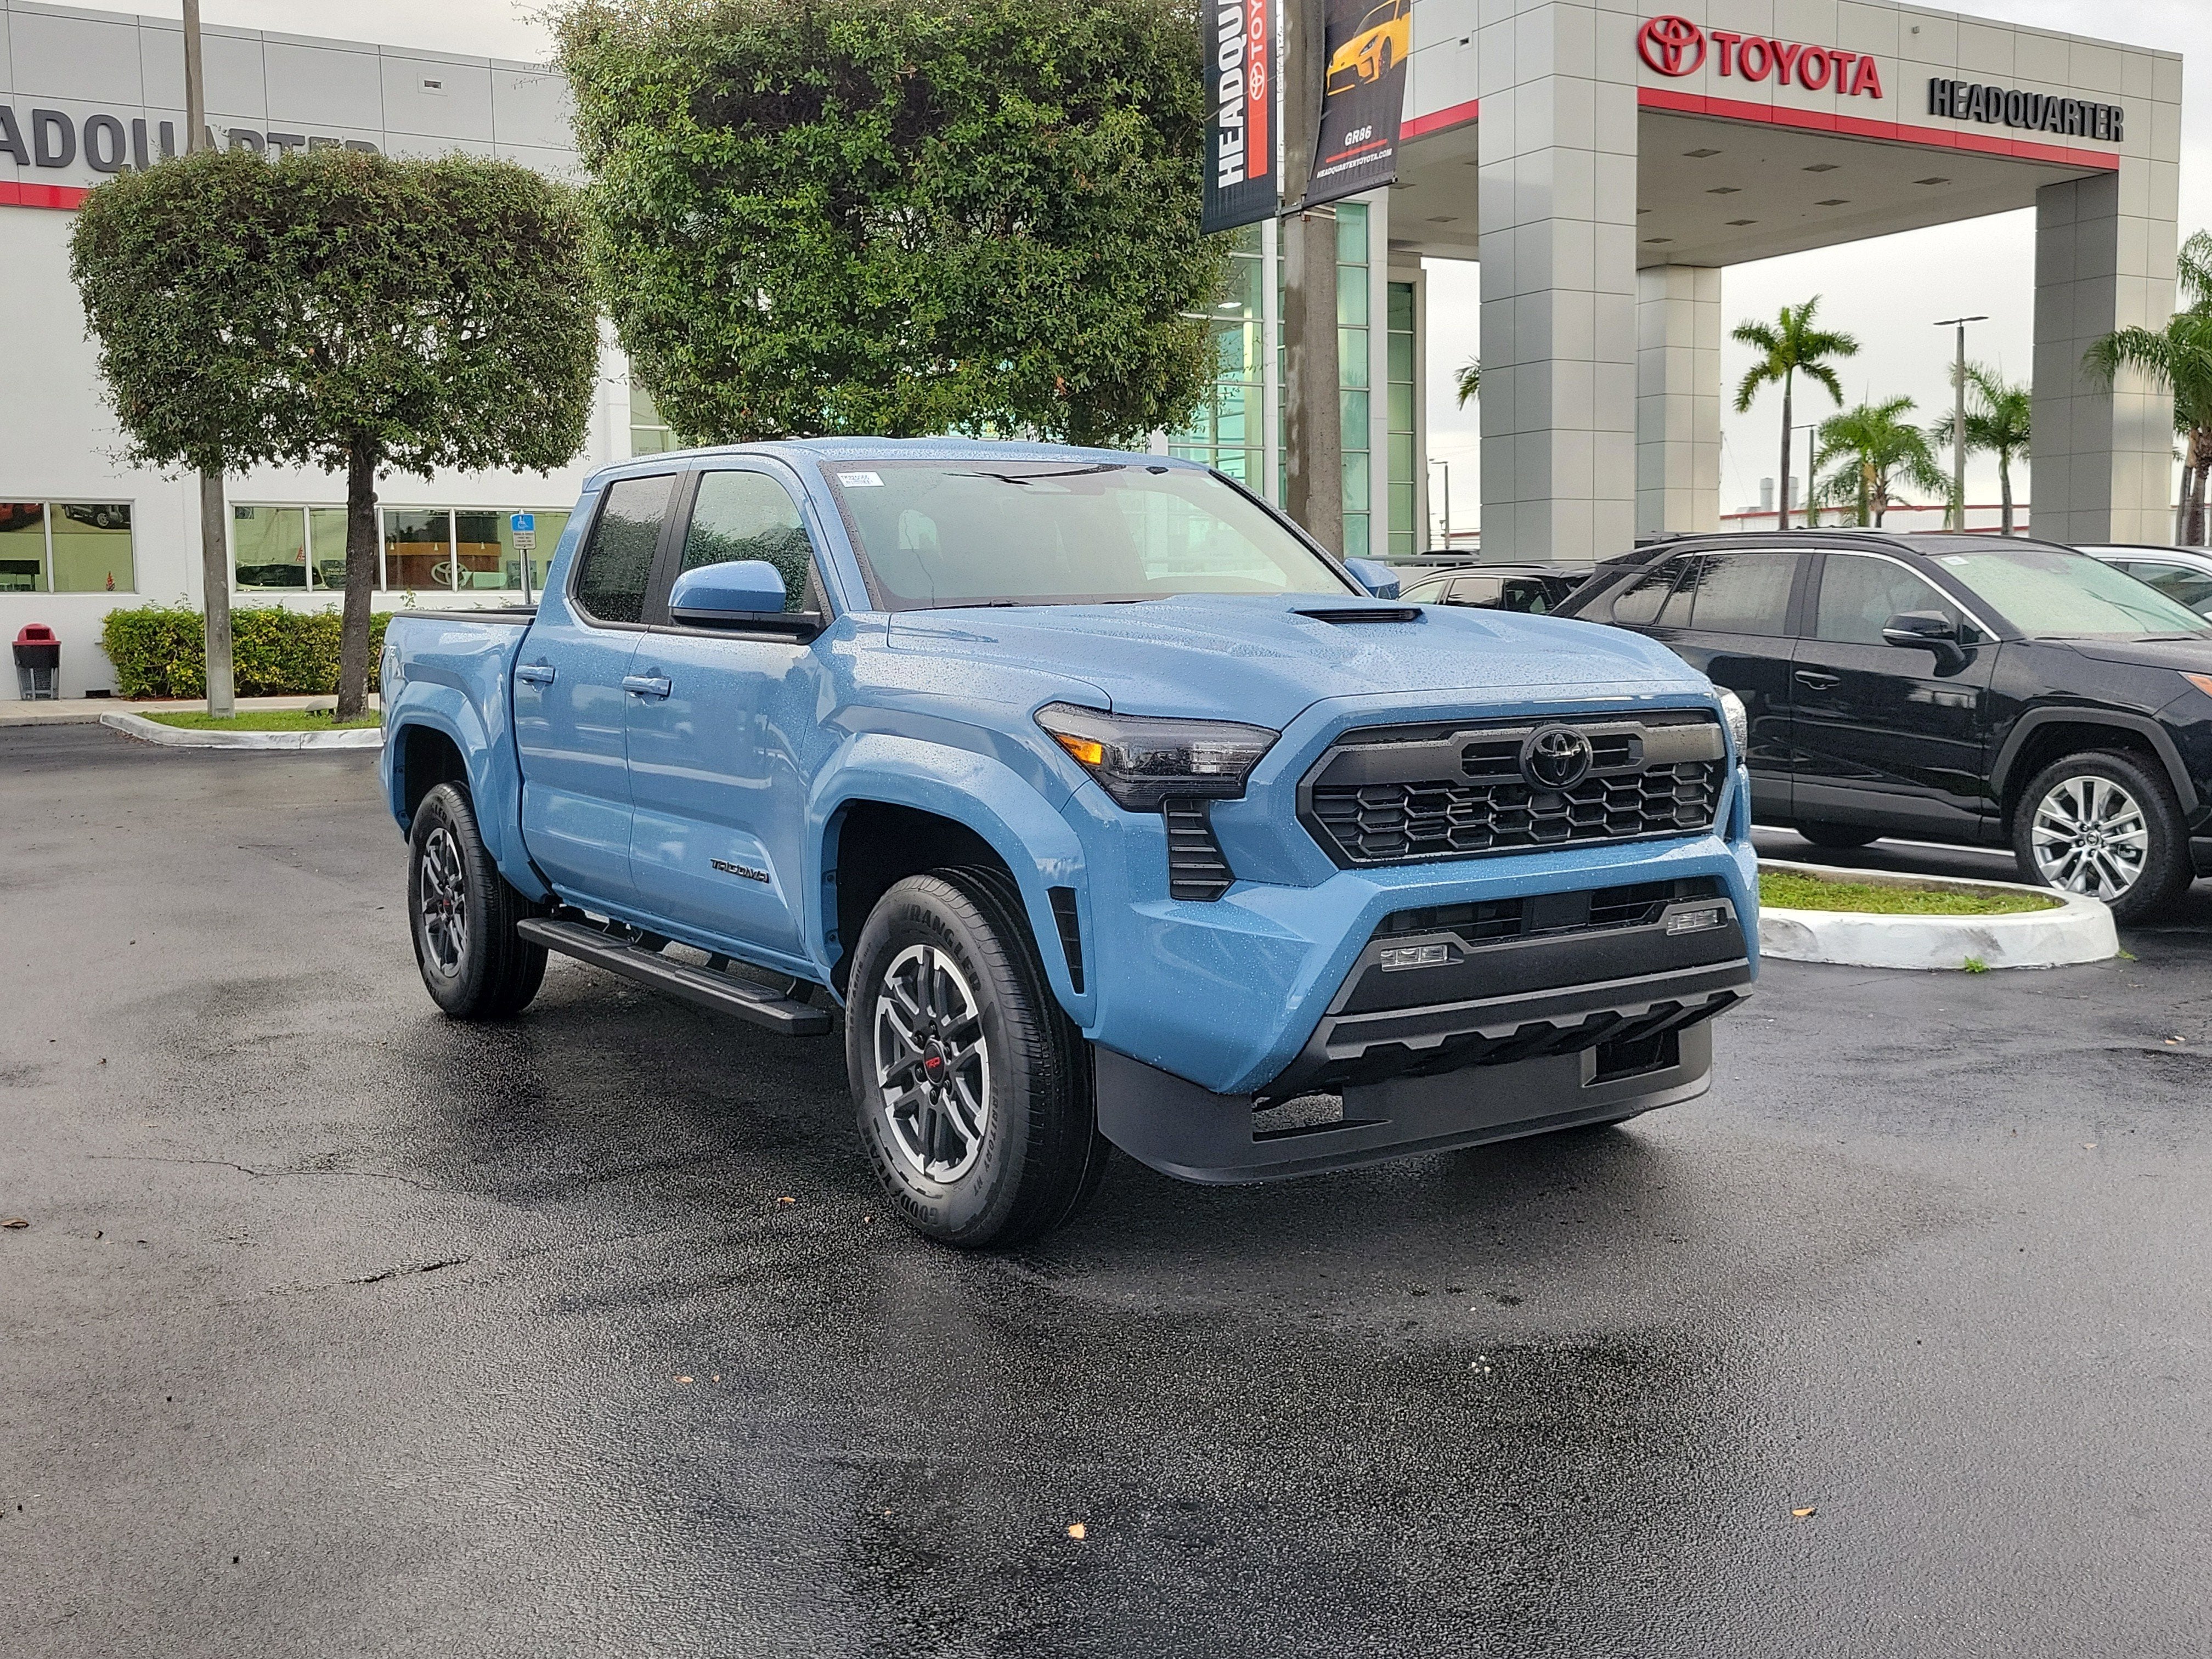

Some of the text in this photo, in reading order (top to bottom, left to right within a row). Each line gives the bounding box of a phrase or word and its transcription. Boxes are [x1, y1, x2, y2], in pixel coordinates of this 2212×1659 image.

[1218, 0, 1247, 189] HEADQU
[1711, 31, 1883, 98] TOYOTA
[1345, 125, 1372, 146] GR86
[1928, 77, 2124, 142] HEADQUARTER
[710, 857, 770, 884] TACOMA
[900, 903, 981, 992] WRANGLER
